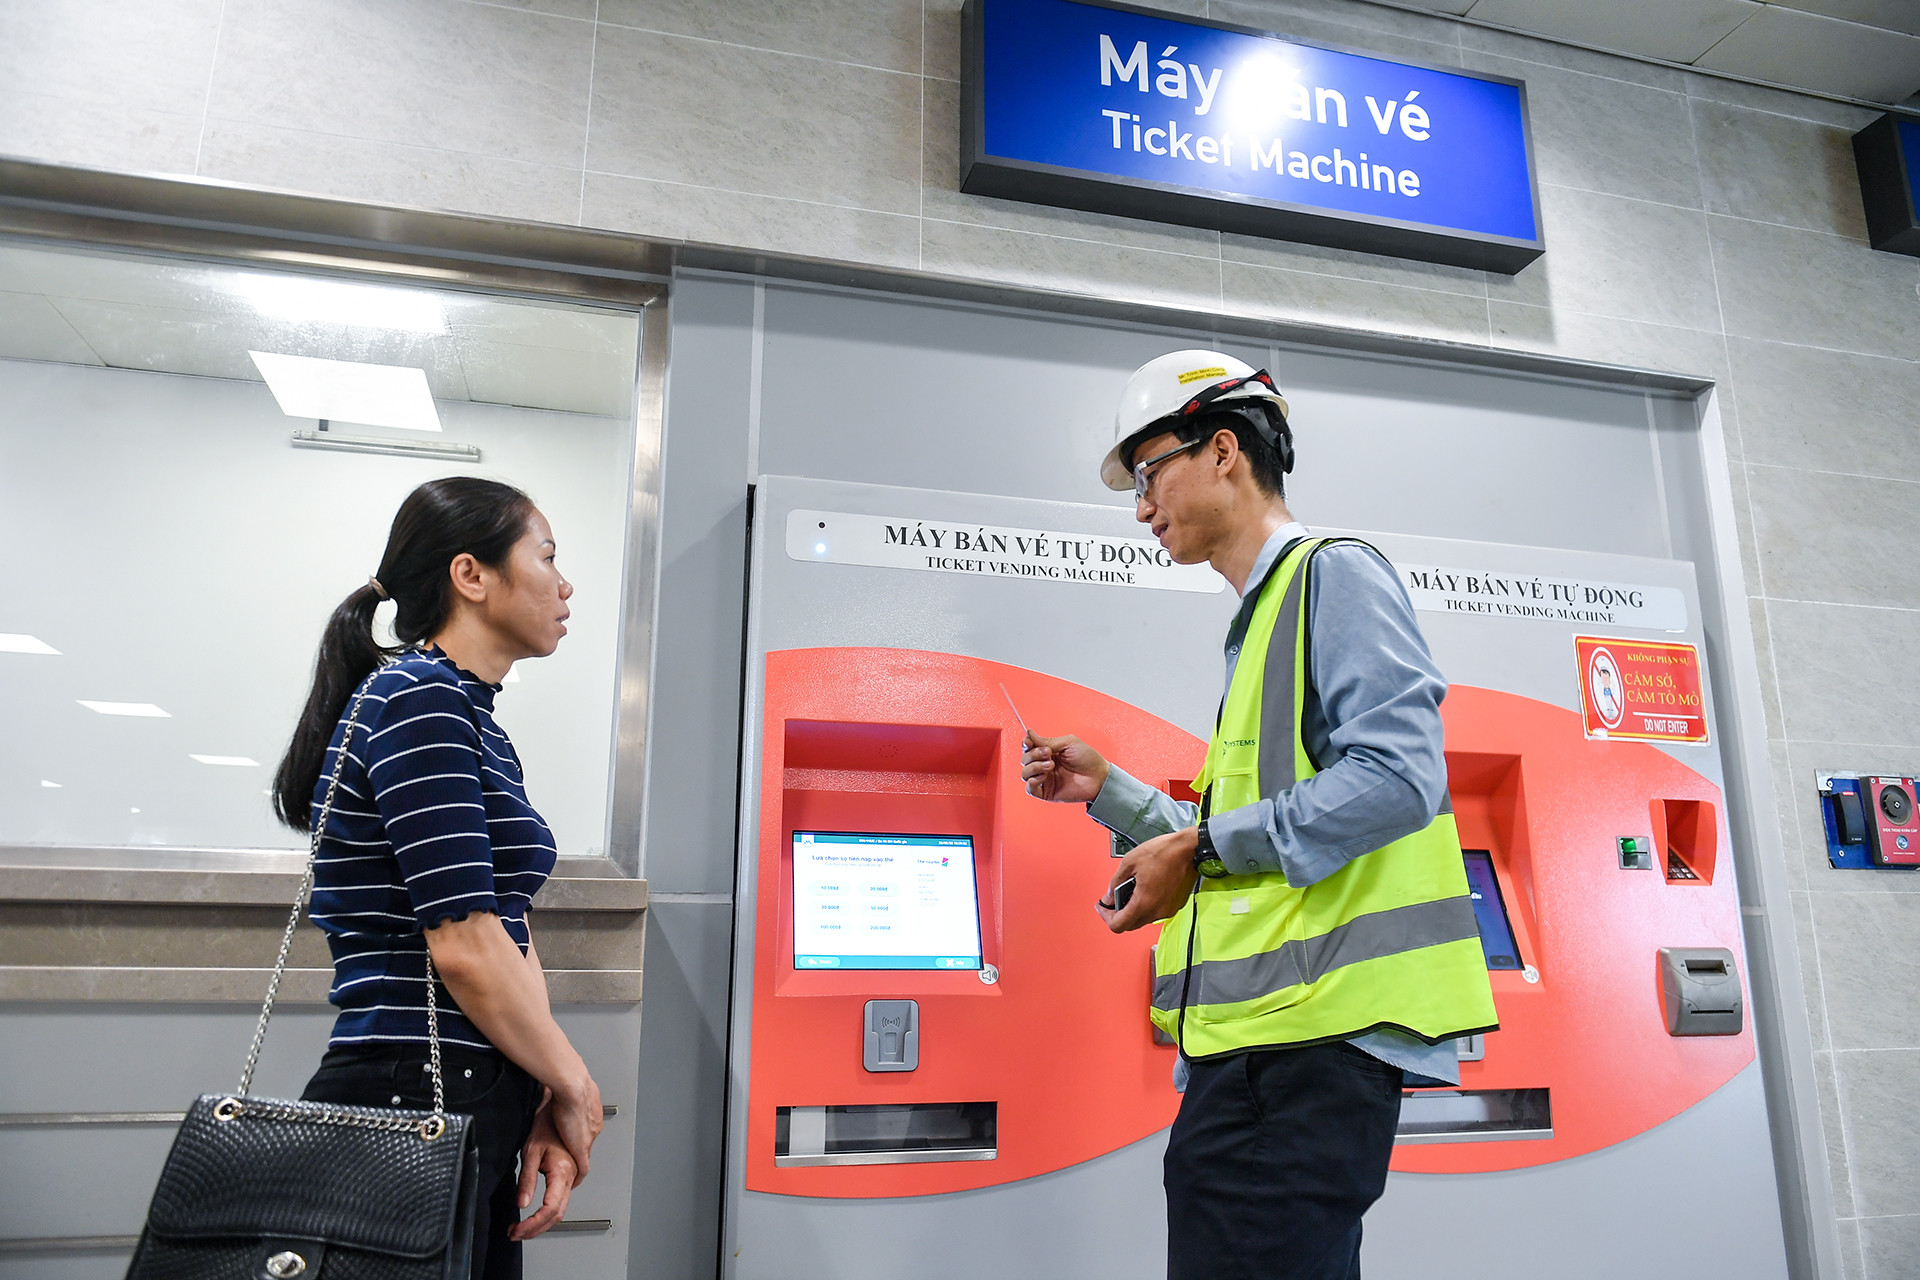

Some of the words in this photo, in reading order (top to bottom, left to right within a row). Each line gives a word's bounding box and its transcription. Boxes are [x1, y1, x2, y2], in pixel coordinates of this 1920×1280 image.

[1099, 34, 1223, 115] Máy
[1243, 60, 1348, 126] án
[1364, 90, 1432, 141] vé
[1102, 109, 1234, 167] Ticket
[1250, 135, 1422, 198] Machine
[883, 520, 947, 550] MÁY
[954, 527, 1008, 553] BÁN
[1015, 533, 1050, 558] VÉ
[1057, 539, 1095, 566] TỰ
[1099, 542, 1172, 569] ĐỘNG
[925, 555, 985, 572] TICKET
[989, 560, 1060, 579] VENDING
[1063, 567, 1136, 585] MACHINE
[1409, 568, 1460, 591] MÁY
[1466, 573, 1510, 596] BÁN
[1515, 578, 1545, 600] VÉ
[1549, 583, 1579, 607] TỰ
[1583, 585, 1644, 610] ĐỘNG
[1445, 598, 1494, 613] TICKET
[1496, 603, 1554, 618] VENDING
[1557, 608, 1616, 624] MACHINE
[1627, 652, 1656, 663] KHÔNG
[1657, 655, 1678, 666] PHẬN
[1644, 718, 1653, 731] DO
[1654, 719, 1667, 732] NOT
[1668, 720, 1689, 734] ENTER
